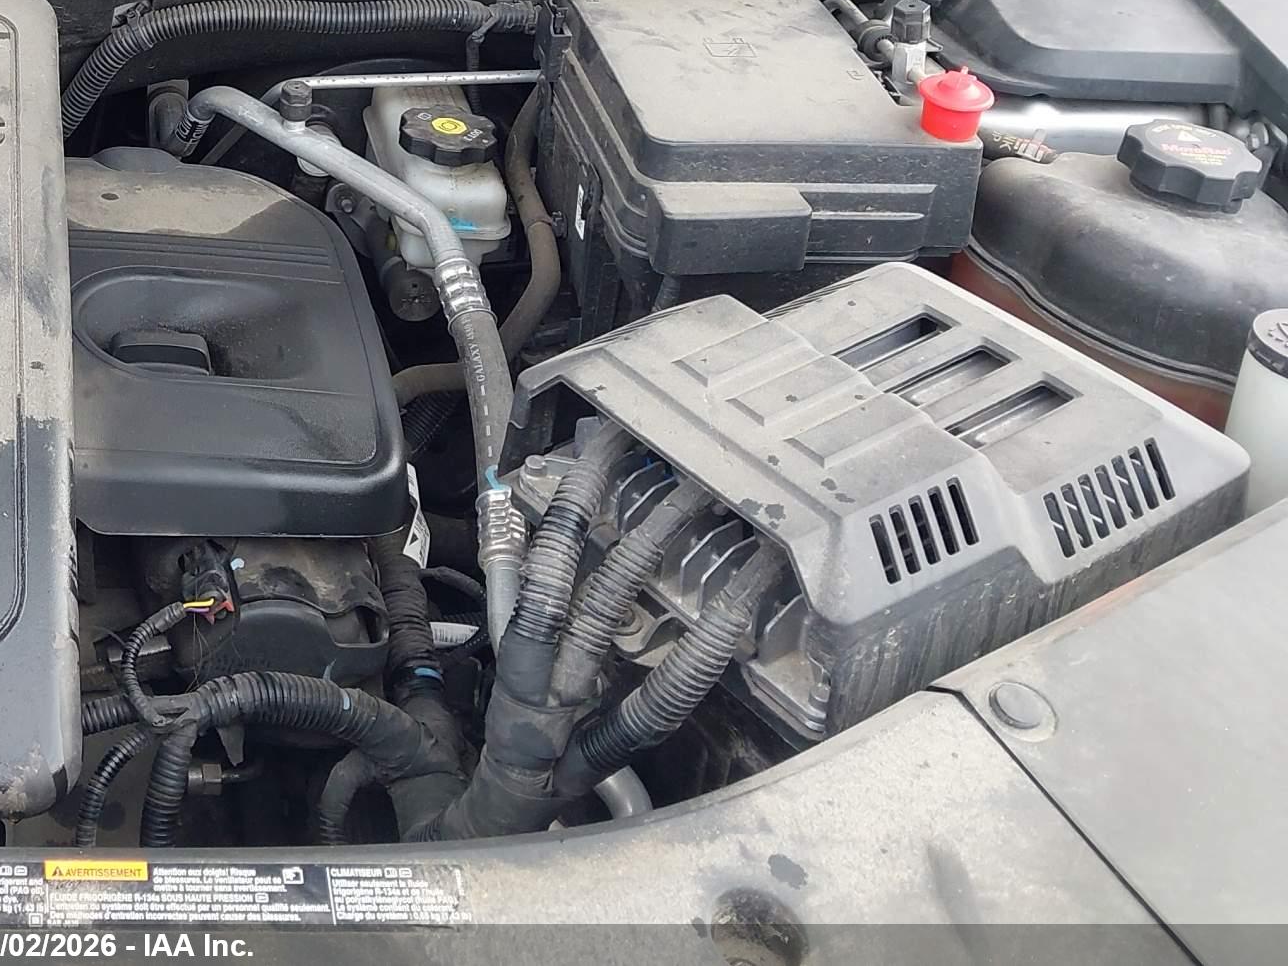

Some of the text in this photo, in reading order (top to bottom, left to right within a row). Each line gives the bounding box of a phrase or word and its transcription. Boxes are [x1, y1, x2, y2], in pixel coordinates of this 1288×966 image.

[65, 868, 142, 877] AVERTISSEMENT
[230, 869, 256, 878] Risque
[330, 868, 383, 877] CLIMATISEUR
[3, 895, 19, 904] dye.
[50, 893, 78, 902] FLUIDE
[134, 893, 160, 902] R-134a
[161, 893, 184, 902] SOUS
[185, 894, 212, 902] HAUTE
[213, 894, 254, 902] PRESSION
